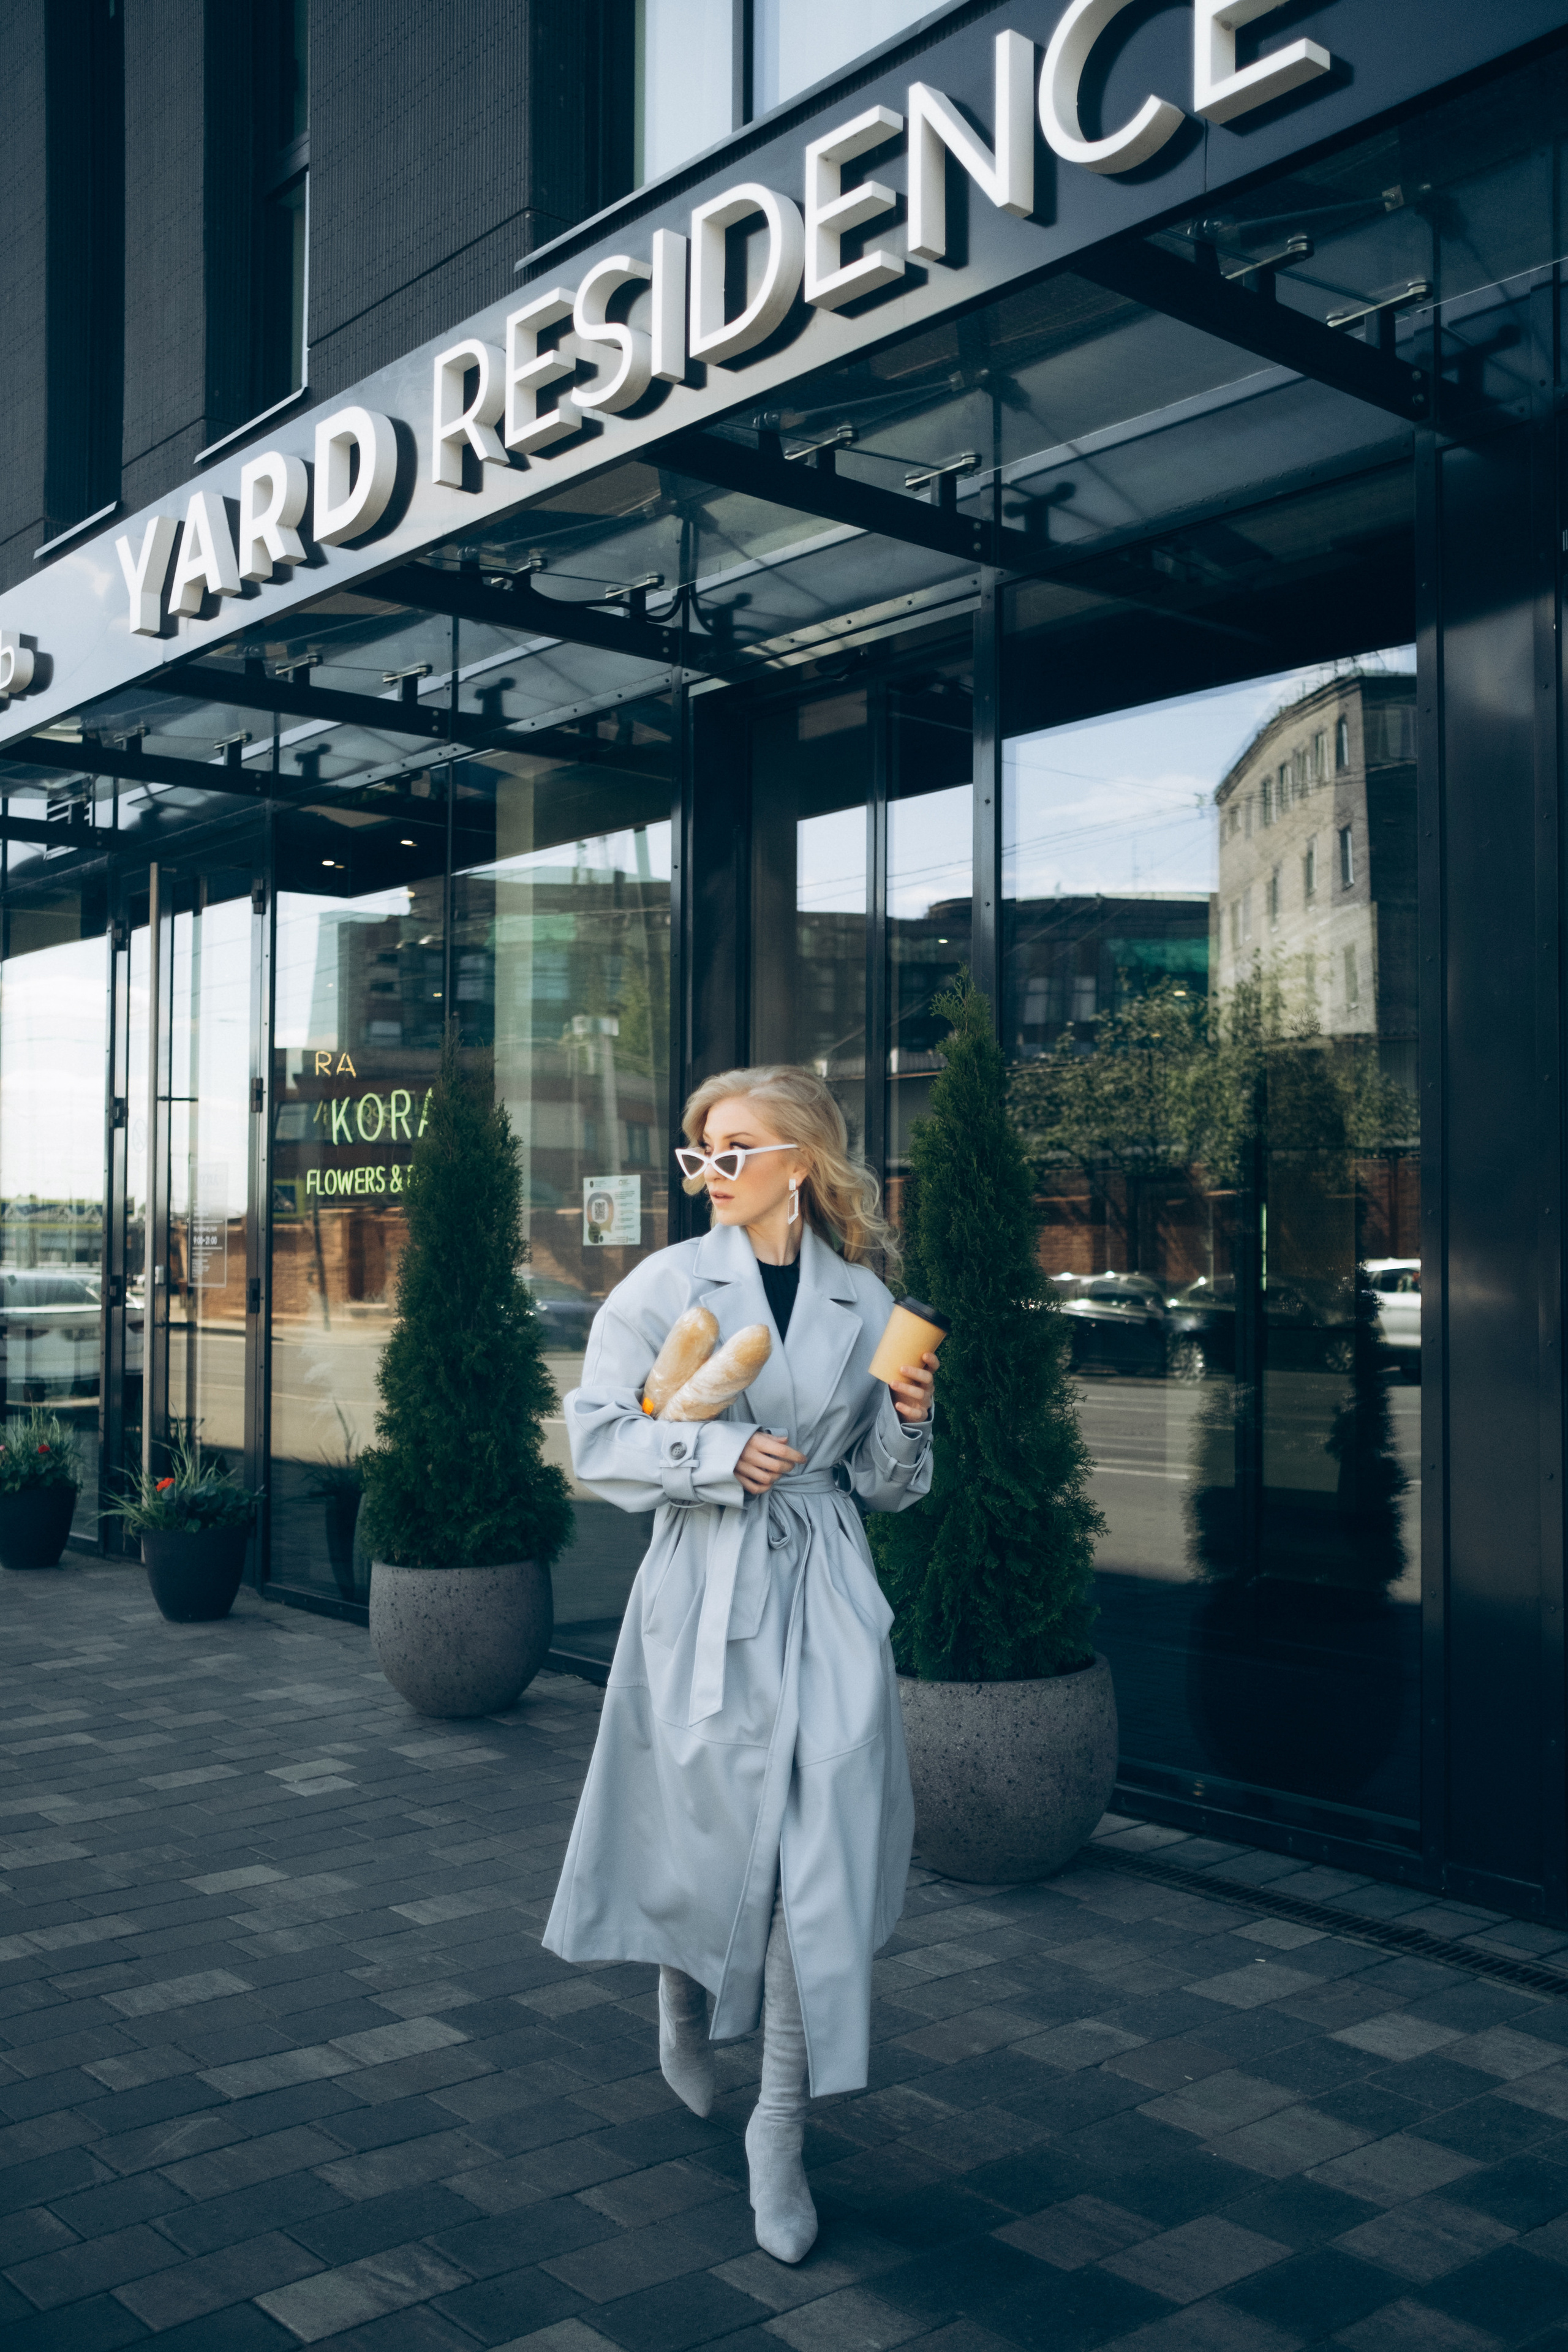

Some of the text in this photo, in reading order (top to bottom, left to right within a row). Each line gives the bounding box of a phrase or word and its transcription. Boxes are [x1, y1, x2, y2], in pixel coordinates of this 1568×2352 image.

[115, 0, 1330, 636] YARD RESIDENCE
[307, 1166, 386, 1195] FLOWERS
[390, 1164, 403, 1193] &
